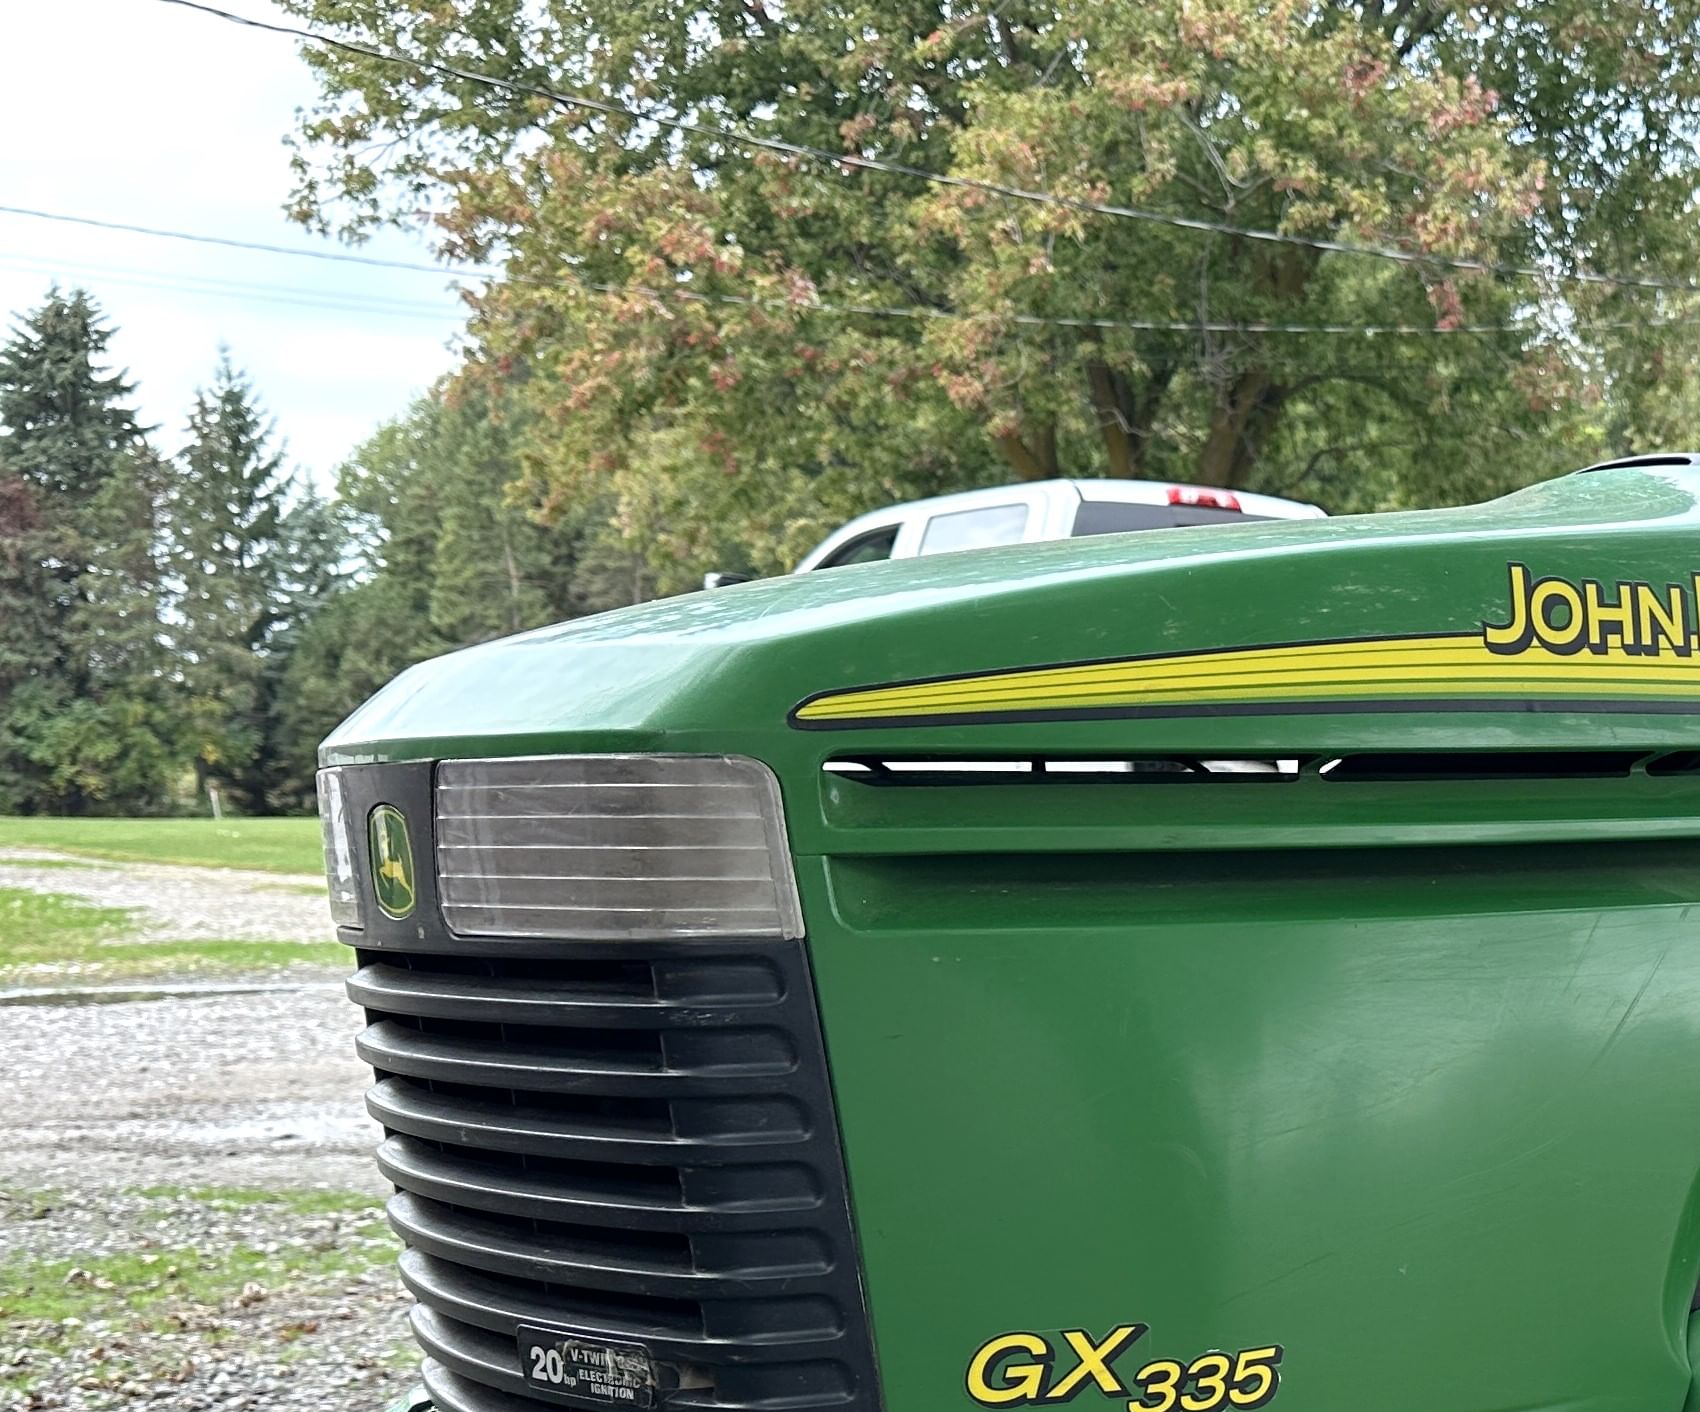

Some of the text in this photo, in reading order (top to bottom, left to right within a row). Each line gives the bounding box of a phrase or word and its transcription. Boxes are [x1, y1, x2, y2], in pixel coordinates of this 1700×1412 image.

[1482, 561, 1692, 657] JOHN
[530, 1346, 564, 1385] 20
[562, 1373, 577, 1389] hp
[578, 1368, 642, 1389] ELECTRONIC
[590, 1382, 635, 1401] IGNITION
